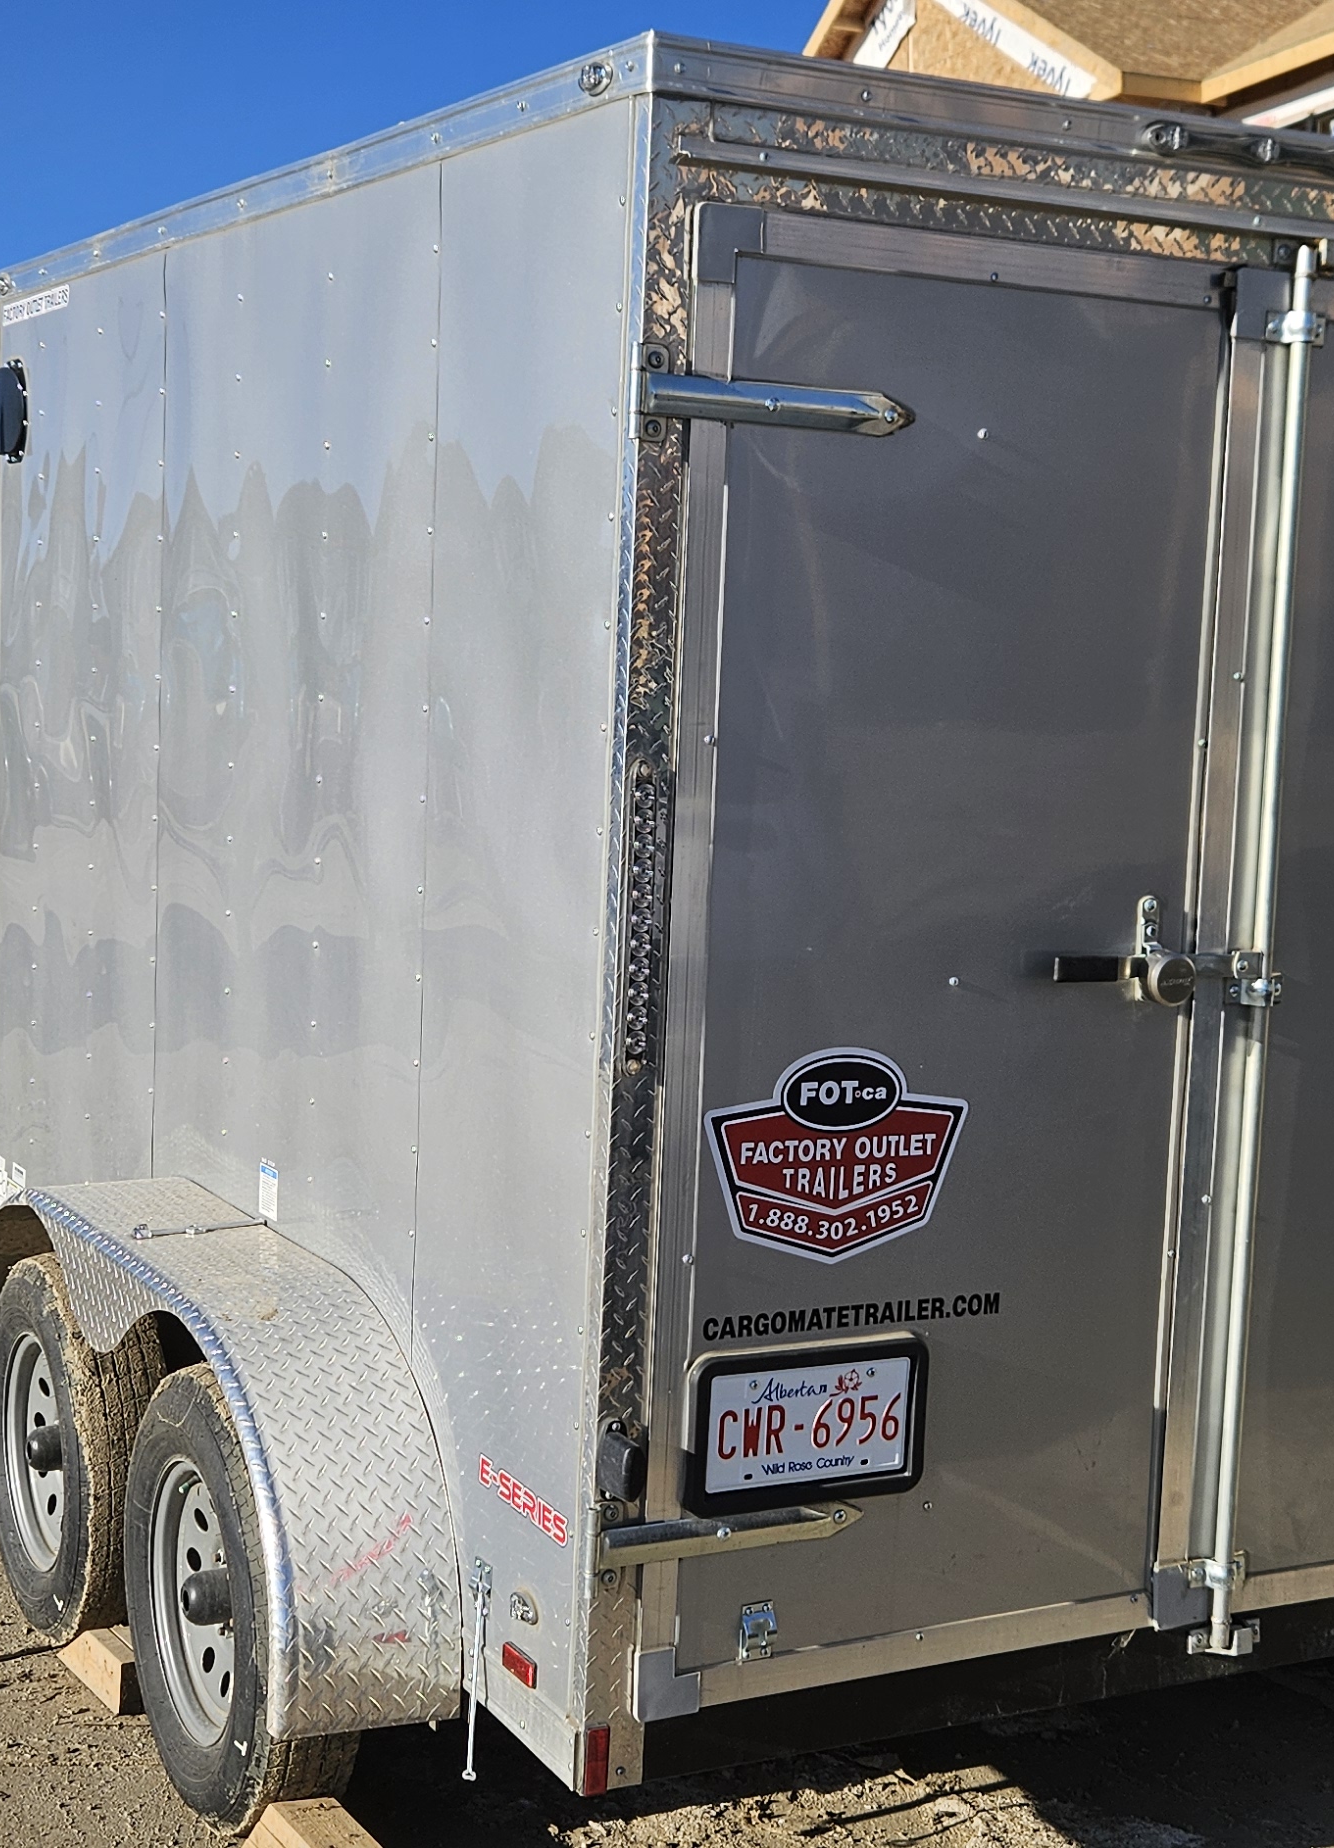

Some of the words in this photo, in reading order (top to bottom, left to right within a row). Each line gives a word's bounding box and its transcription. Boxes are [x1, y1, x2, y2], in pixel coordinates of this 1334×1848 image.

[739, 1137, 848, 1165] FACTORY
[854, 1133, 937, 1159] OUTLET
[782, 1162, 898, 1201] TRAILERS
[747, 1194, 919, 1240] 1.888.302.1952
[702, 1292, 1001, 1342] CARGOMATETRAILER.COM
[751, 1377, 821, 1404] Alberta
[717, 1392, 902, 1460] CWR-6956
[761, 1462, 786, 1477] Wild
[787, 1459, 814, 1474] Rose
[816, 1454, 856, 1471] Country
[479, 1453, 569, 1547] E-SERIES
